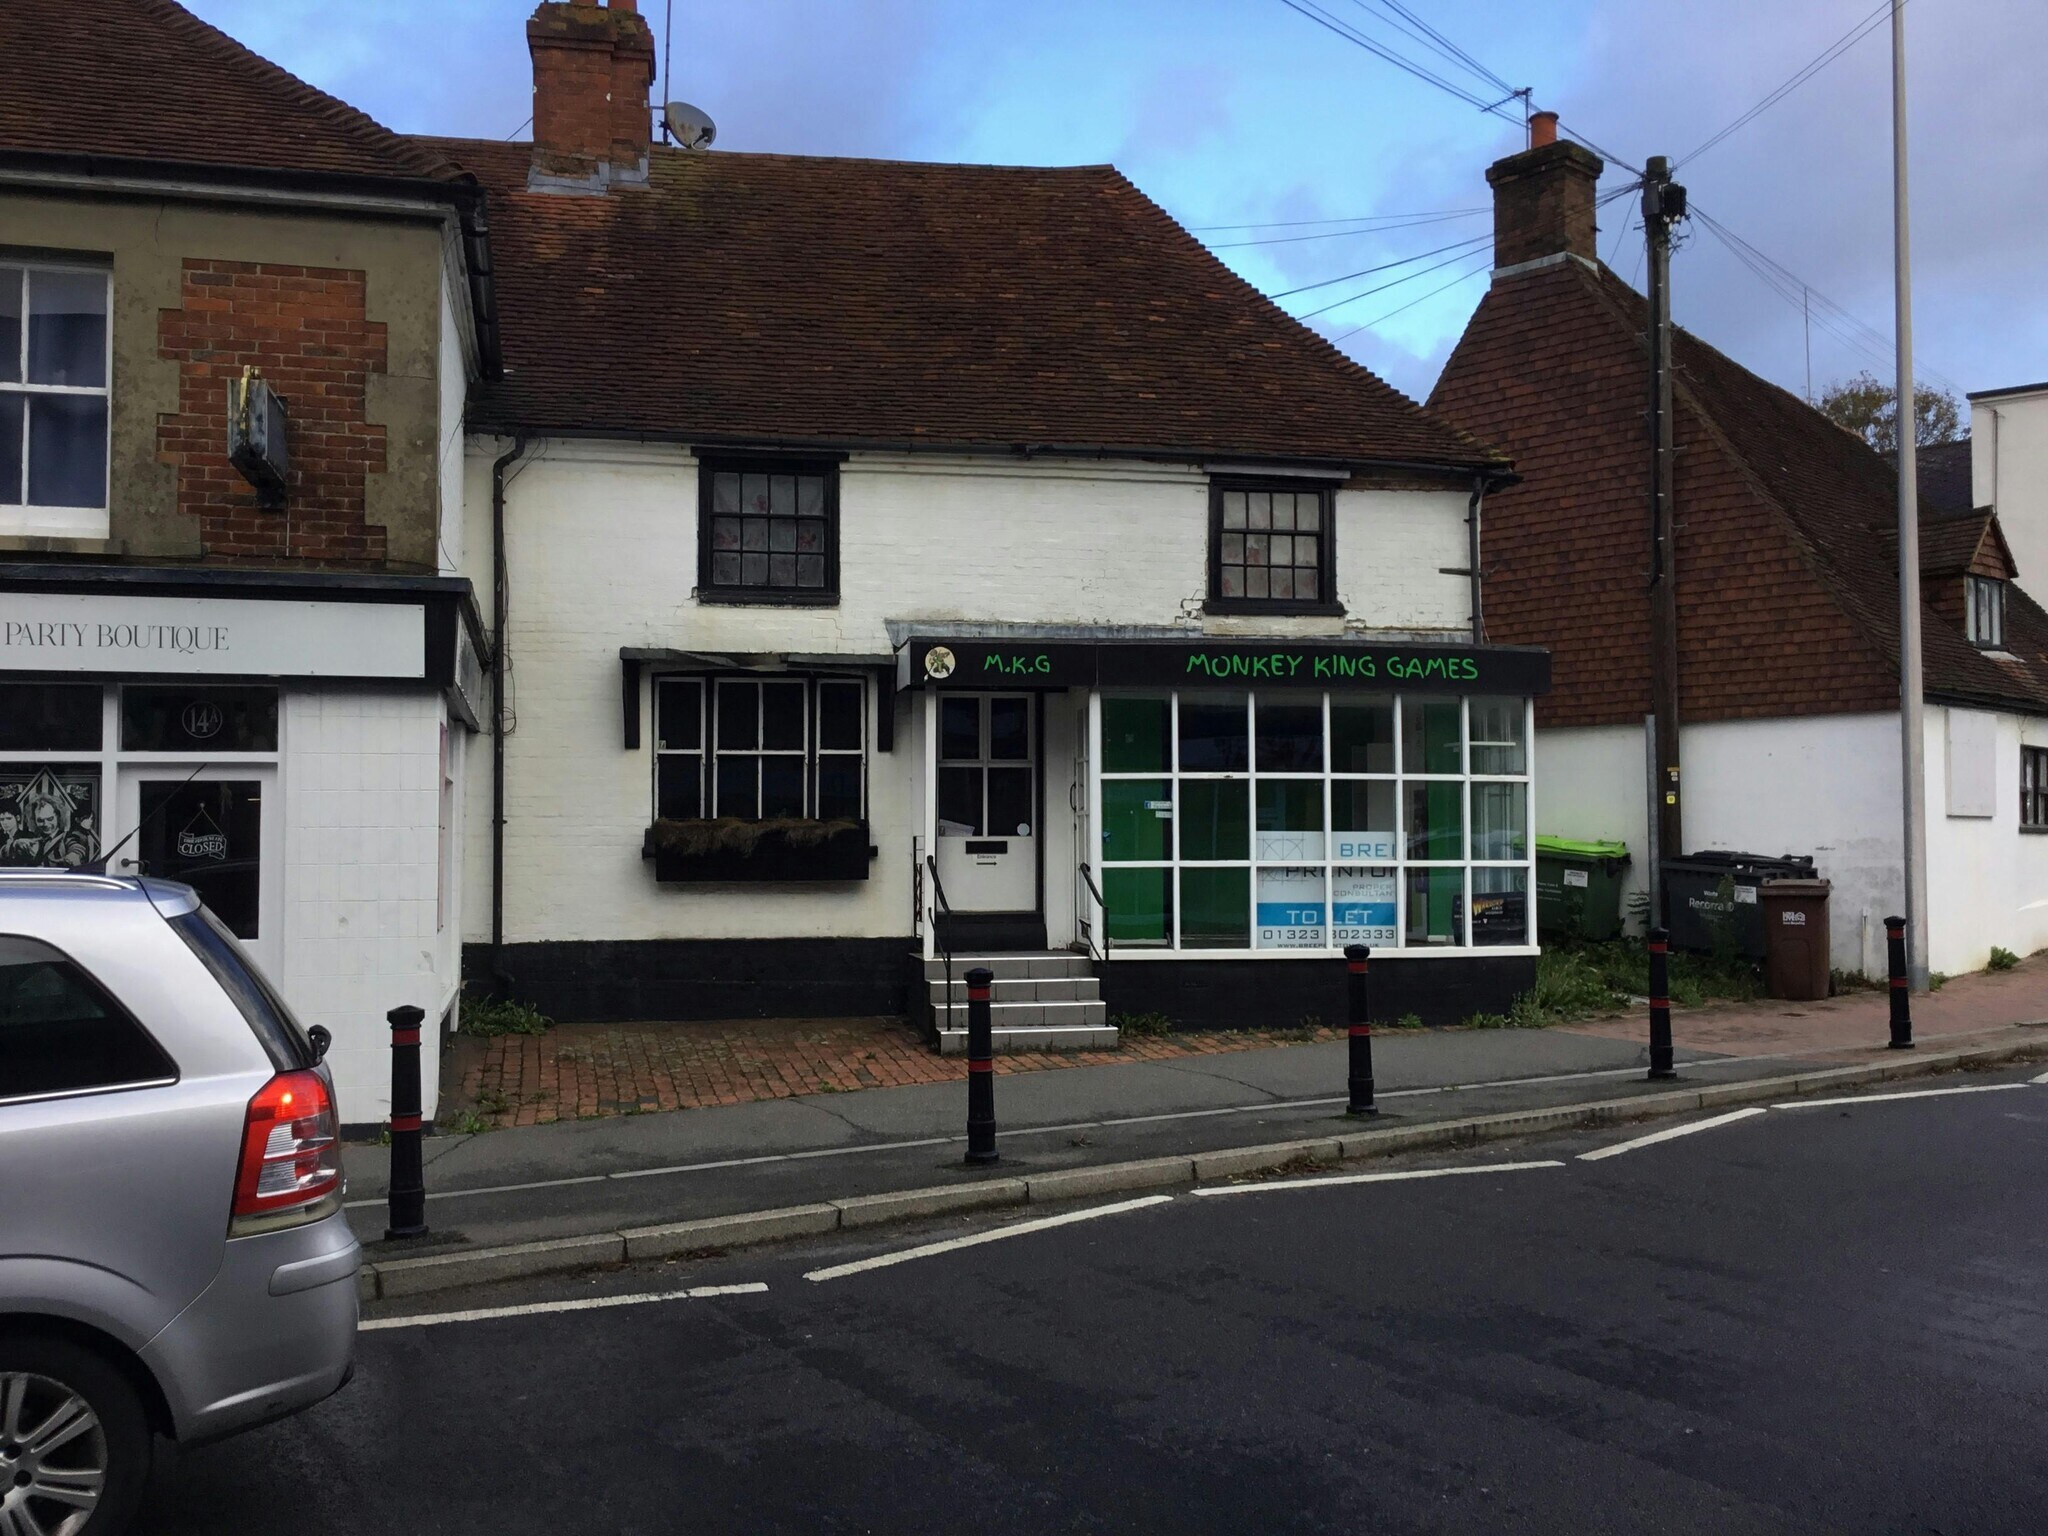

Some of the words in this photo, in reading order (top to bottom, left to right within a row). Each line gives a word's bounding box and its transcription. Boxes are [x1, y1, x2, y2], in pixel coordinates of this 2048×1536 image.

[4, 621, 88, 647] PARTY
[97, 624, 230, 654] BOUTIQUE
[984, 654, 1050, 674] M.K.G
[1186, 654, 1303, 677] MONKEY
[1314, 655, 1376, 678] KING
[1387, 656, 1479, 679] GAMES
[181, 841, 223, 854] CLOSED
[1286, 910, 1317, 924] TO
[1263, 930, 1319, 939] 01323
